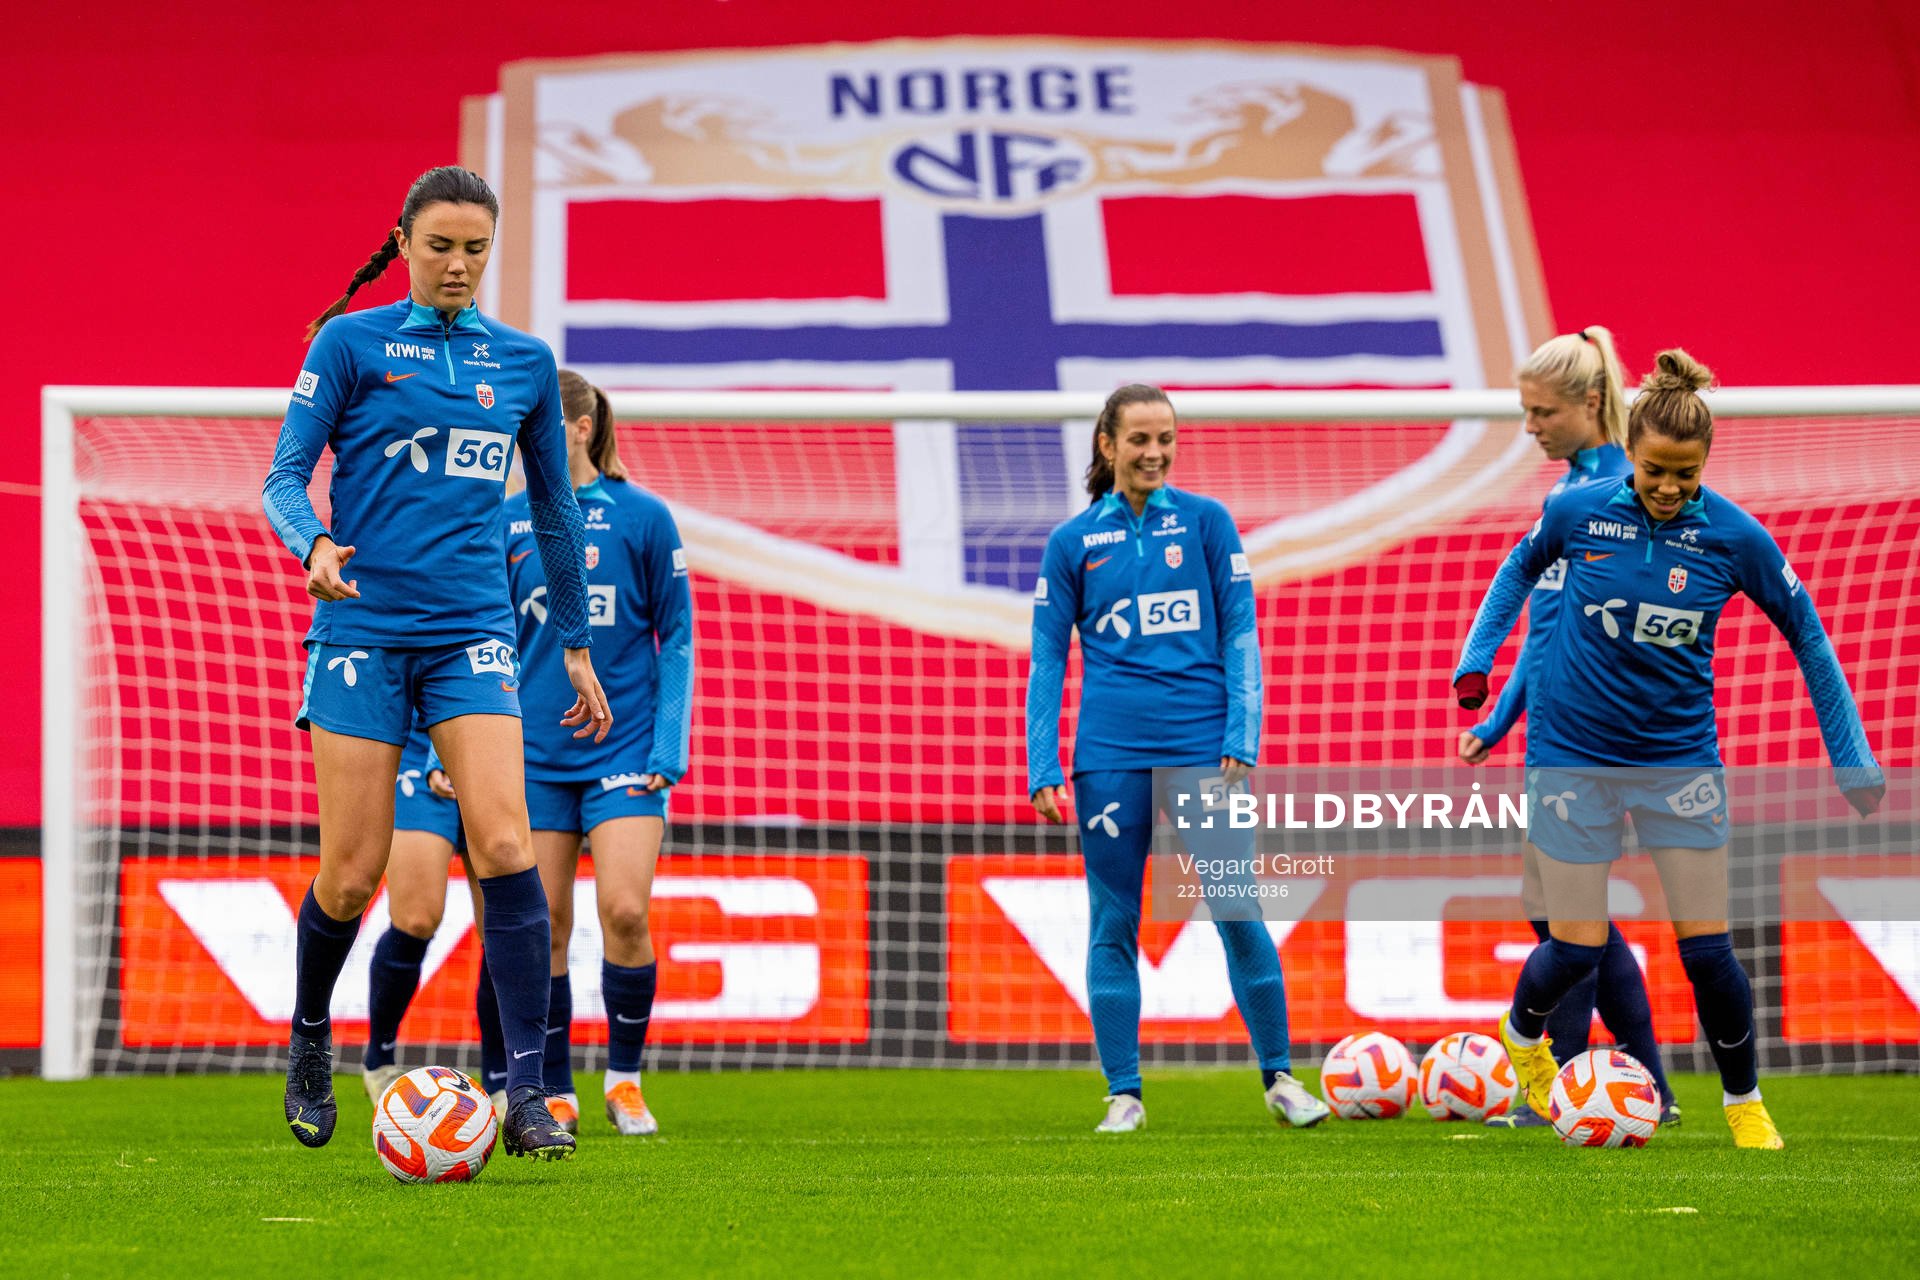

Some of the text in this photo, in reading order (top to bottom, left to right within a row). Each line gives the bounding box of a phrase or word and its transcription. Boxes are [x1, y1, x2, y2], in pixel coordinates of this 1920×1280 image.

[829, 66, 1136, 118] NORGE
[385, 342, 420, 359] KIWI
[454, 438, 504, 472] 5G
[1588, 520, 1621, 538] KIWI
[1148, 600, 1191, 625] 5G
[1642, 614, 1693, 639] 5G
[477, 645, 510, 668] 5G
[1678, 782, 1715, 811] 5G
